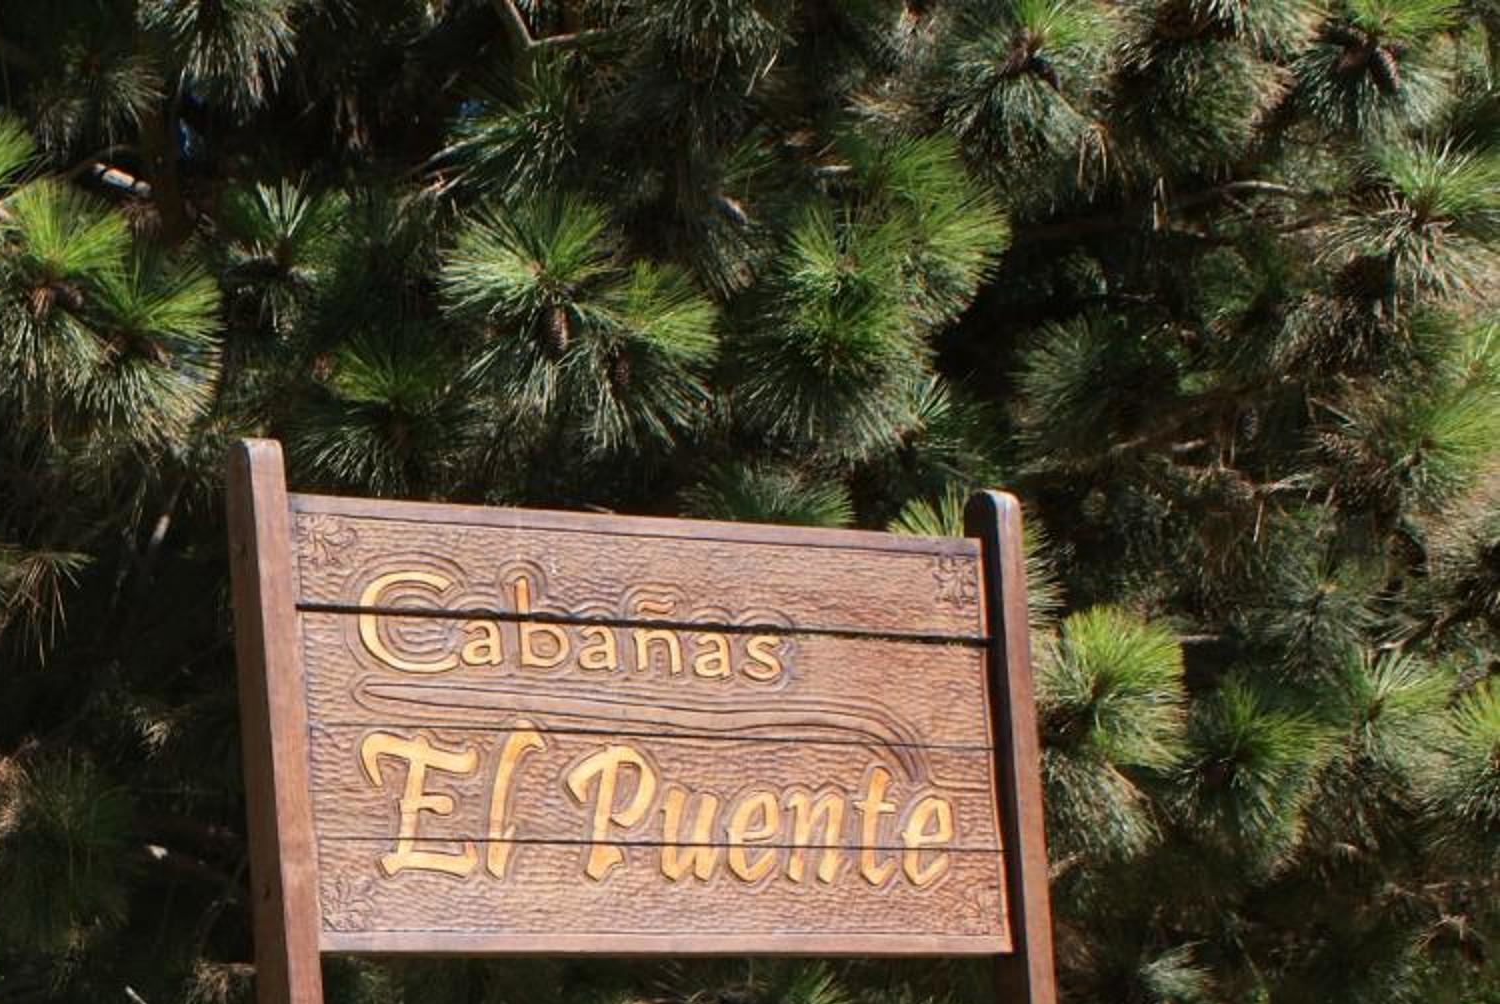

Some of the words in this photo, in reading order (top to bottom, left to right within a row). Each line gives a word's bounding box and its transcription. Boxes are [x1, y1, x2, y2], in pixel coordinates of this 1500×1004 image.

[357, 570, 783, 682] Cabañas
[359, 722, 546, 879] El
[566, 744, 953, 886] Puente
